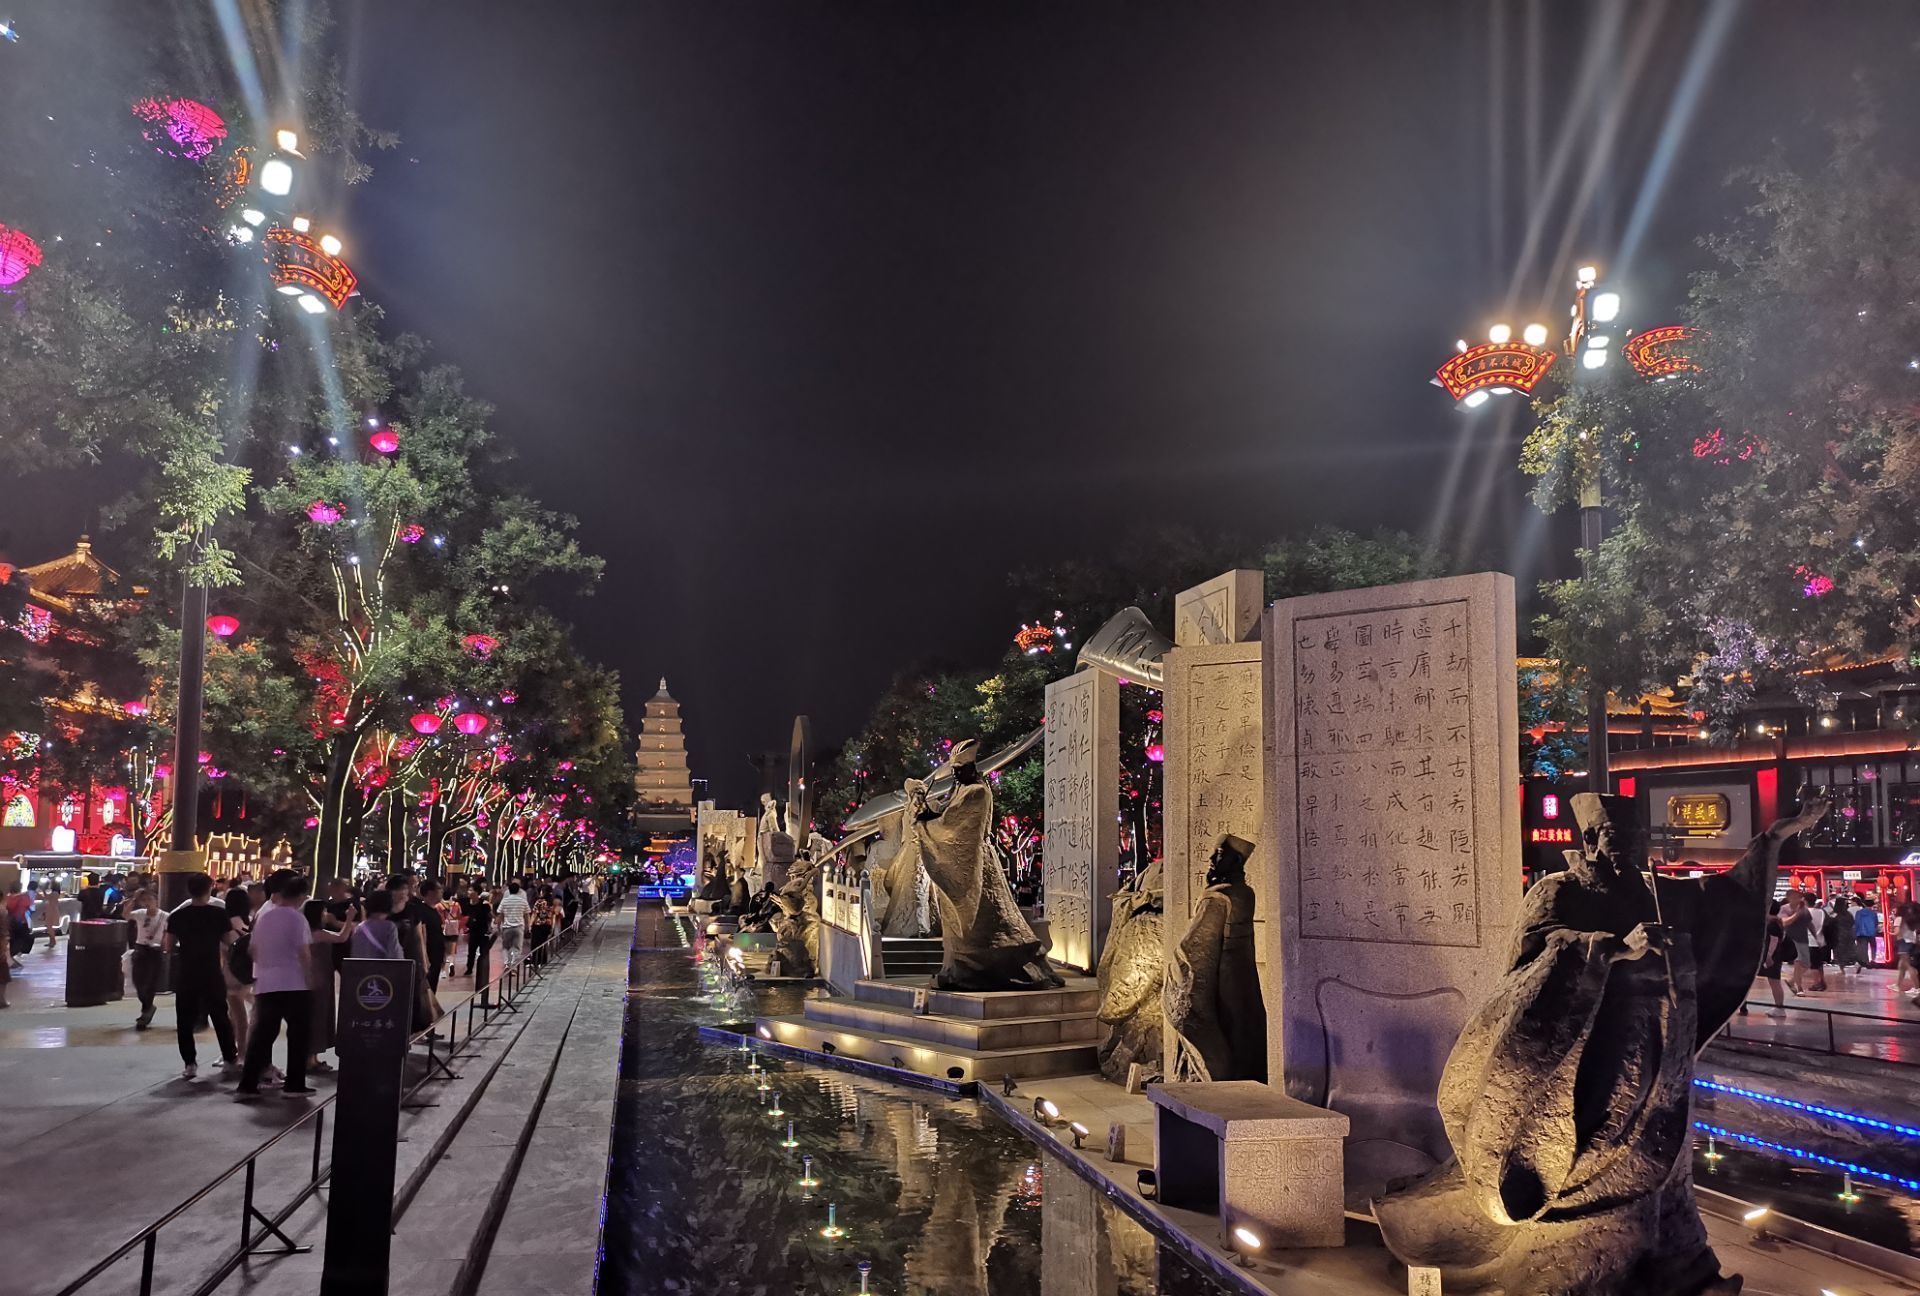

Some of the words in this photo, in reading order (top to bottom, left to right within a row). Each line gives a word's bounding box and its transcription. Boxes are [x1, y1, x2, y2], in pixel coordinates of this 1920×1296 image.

[1466, 355, 1523, 376] 大唐不夜城
